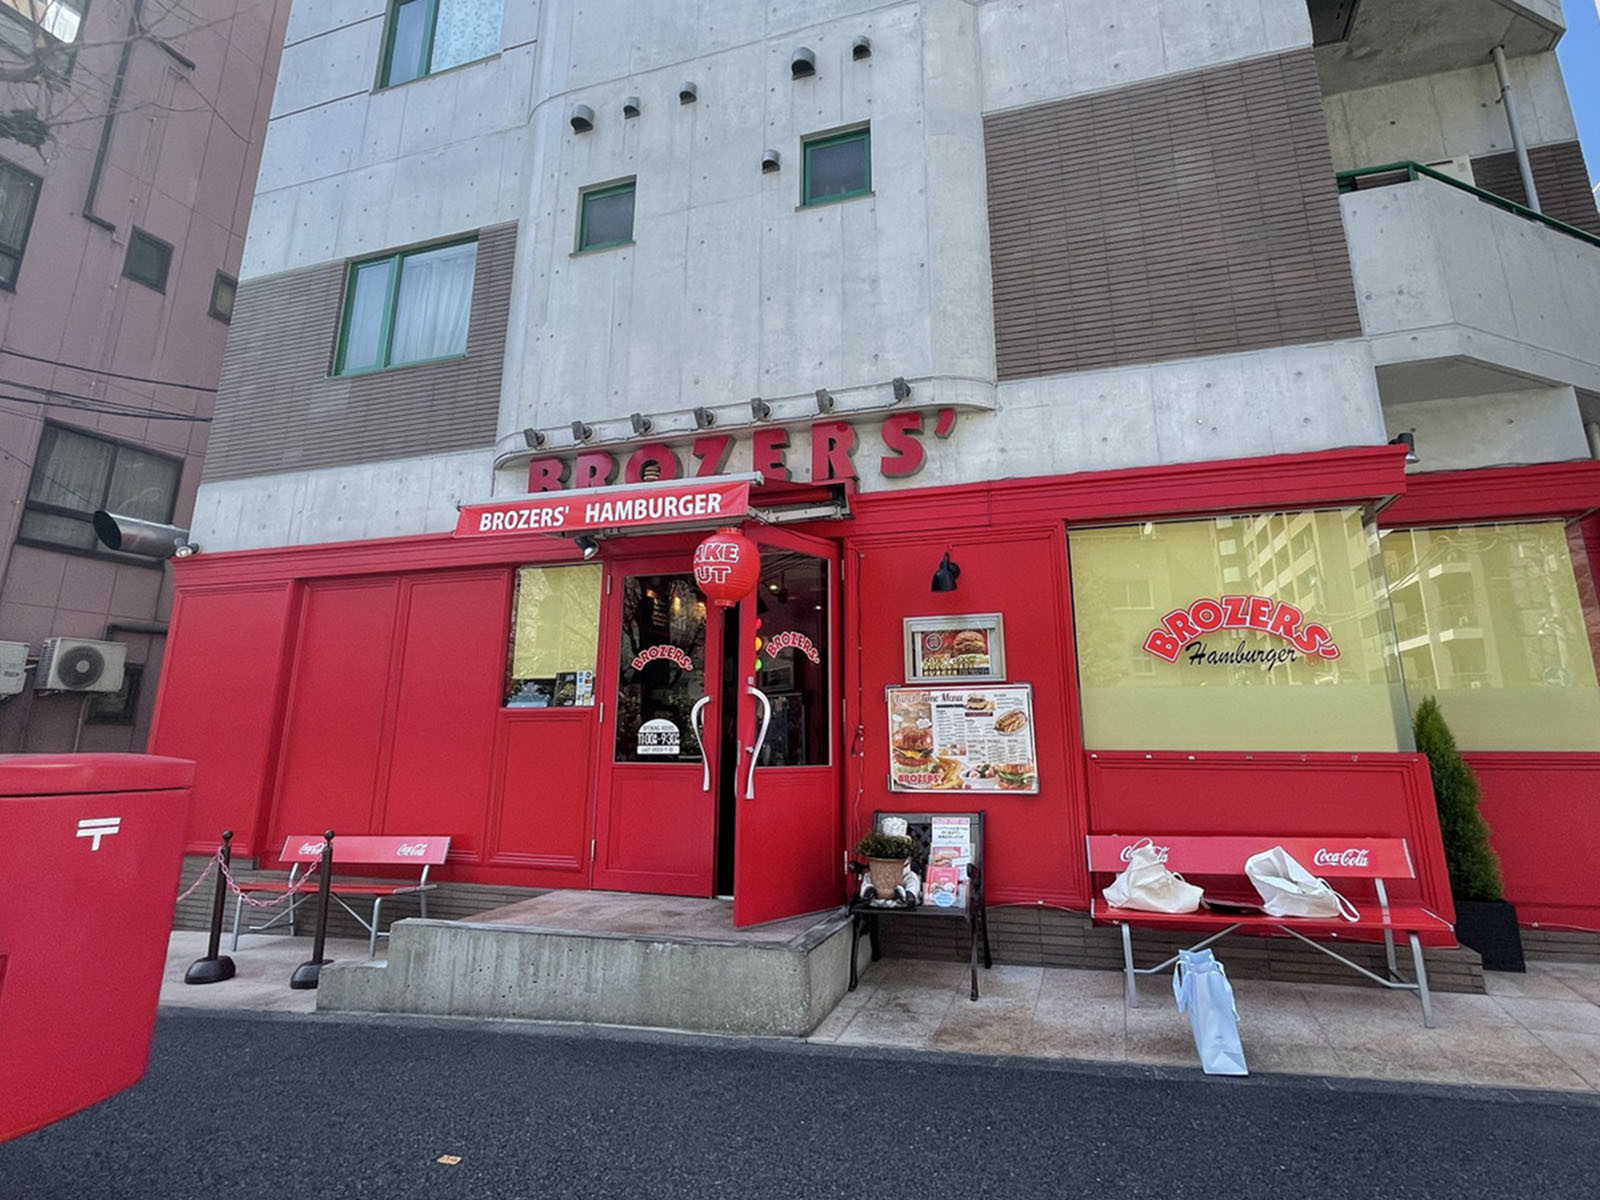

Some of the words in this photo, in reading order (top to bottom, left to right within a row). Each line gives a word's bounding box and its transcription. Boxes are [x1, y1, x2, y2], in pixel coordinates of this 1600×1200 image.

[528, 409, 956, 494] BROZERS'
[479, 505, 569, 532] BROZERS'
[585, 493, 722, 523] HAMBURGER
[694, 543, 739, 563] AKE
[694, 566, 732, 584] UT
[1142, 595, 1341, 664] BROZERS'
[1185, 640, 1298, 671] Hamburger
[1314, 848, 1369, 867] Coca-Cola
